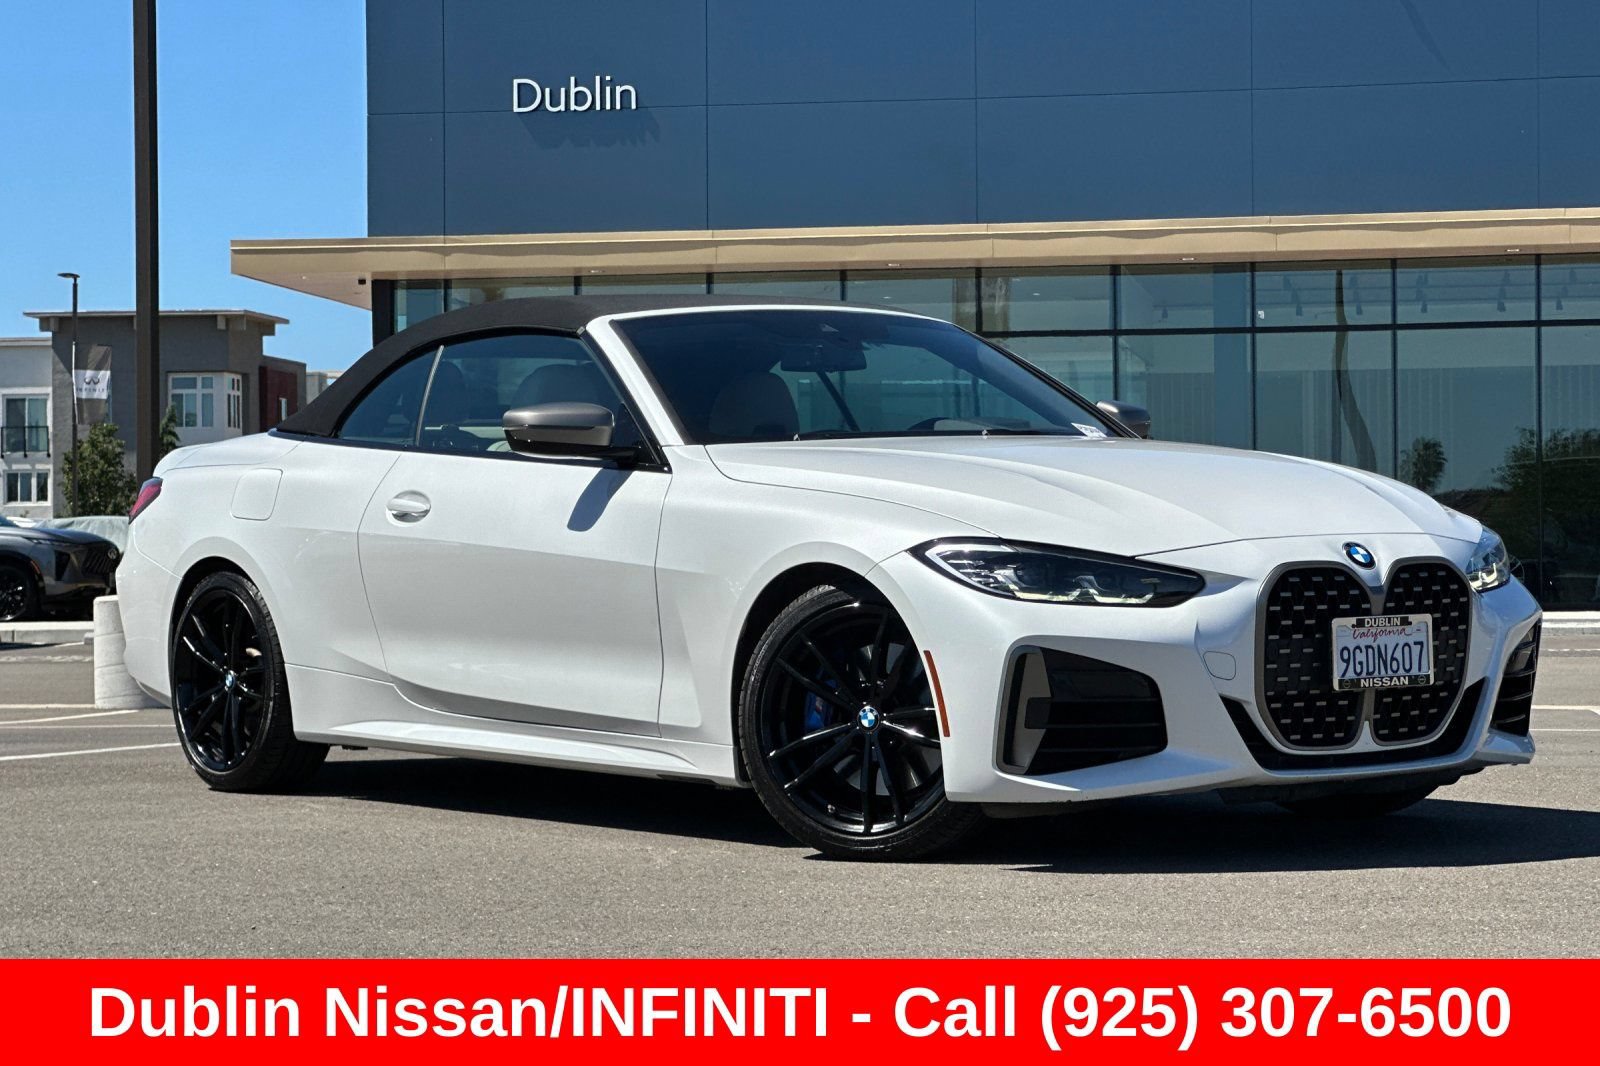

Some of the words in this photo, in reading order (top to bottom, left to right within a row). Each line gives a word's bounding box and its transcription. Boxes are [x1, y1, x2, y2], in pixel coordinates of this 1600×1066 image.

[513, 76, 637, 112] Dublin
[1364, 617, 1400, 627] DUBLIN
[1352, 627, 1412, 642] California
[1340, 641, 1424, 678] 9GDN607
[1360, 676, 1409, 688] NISSAN
